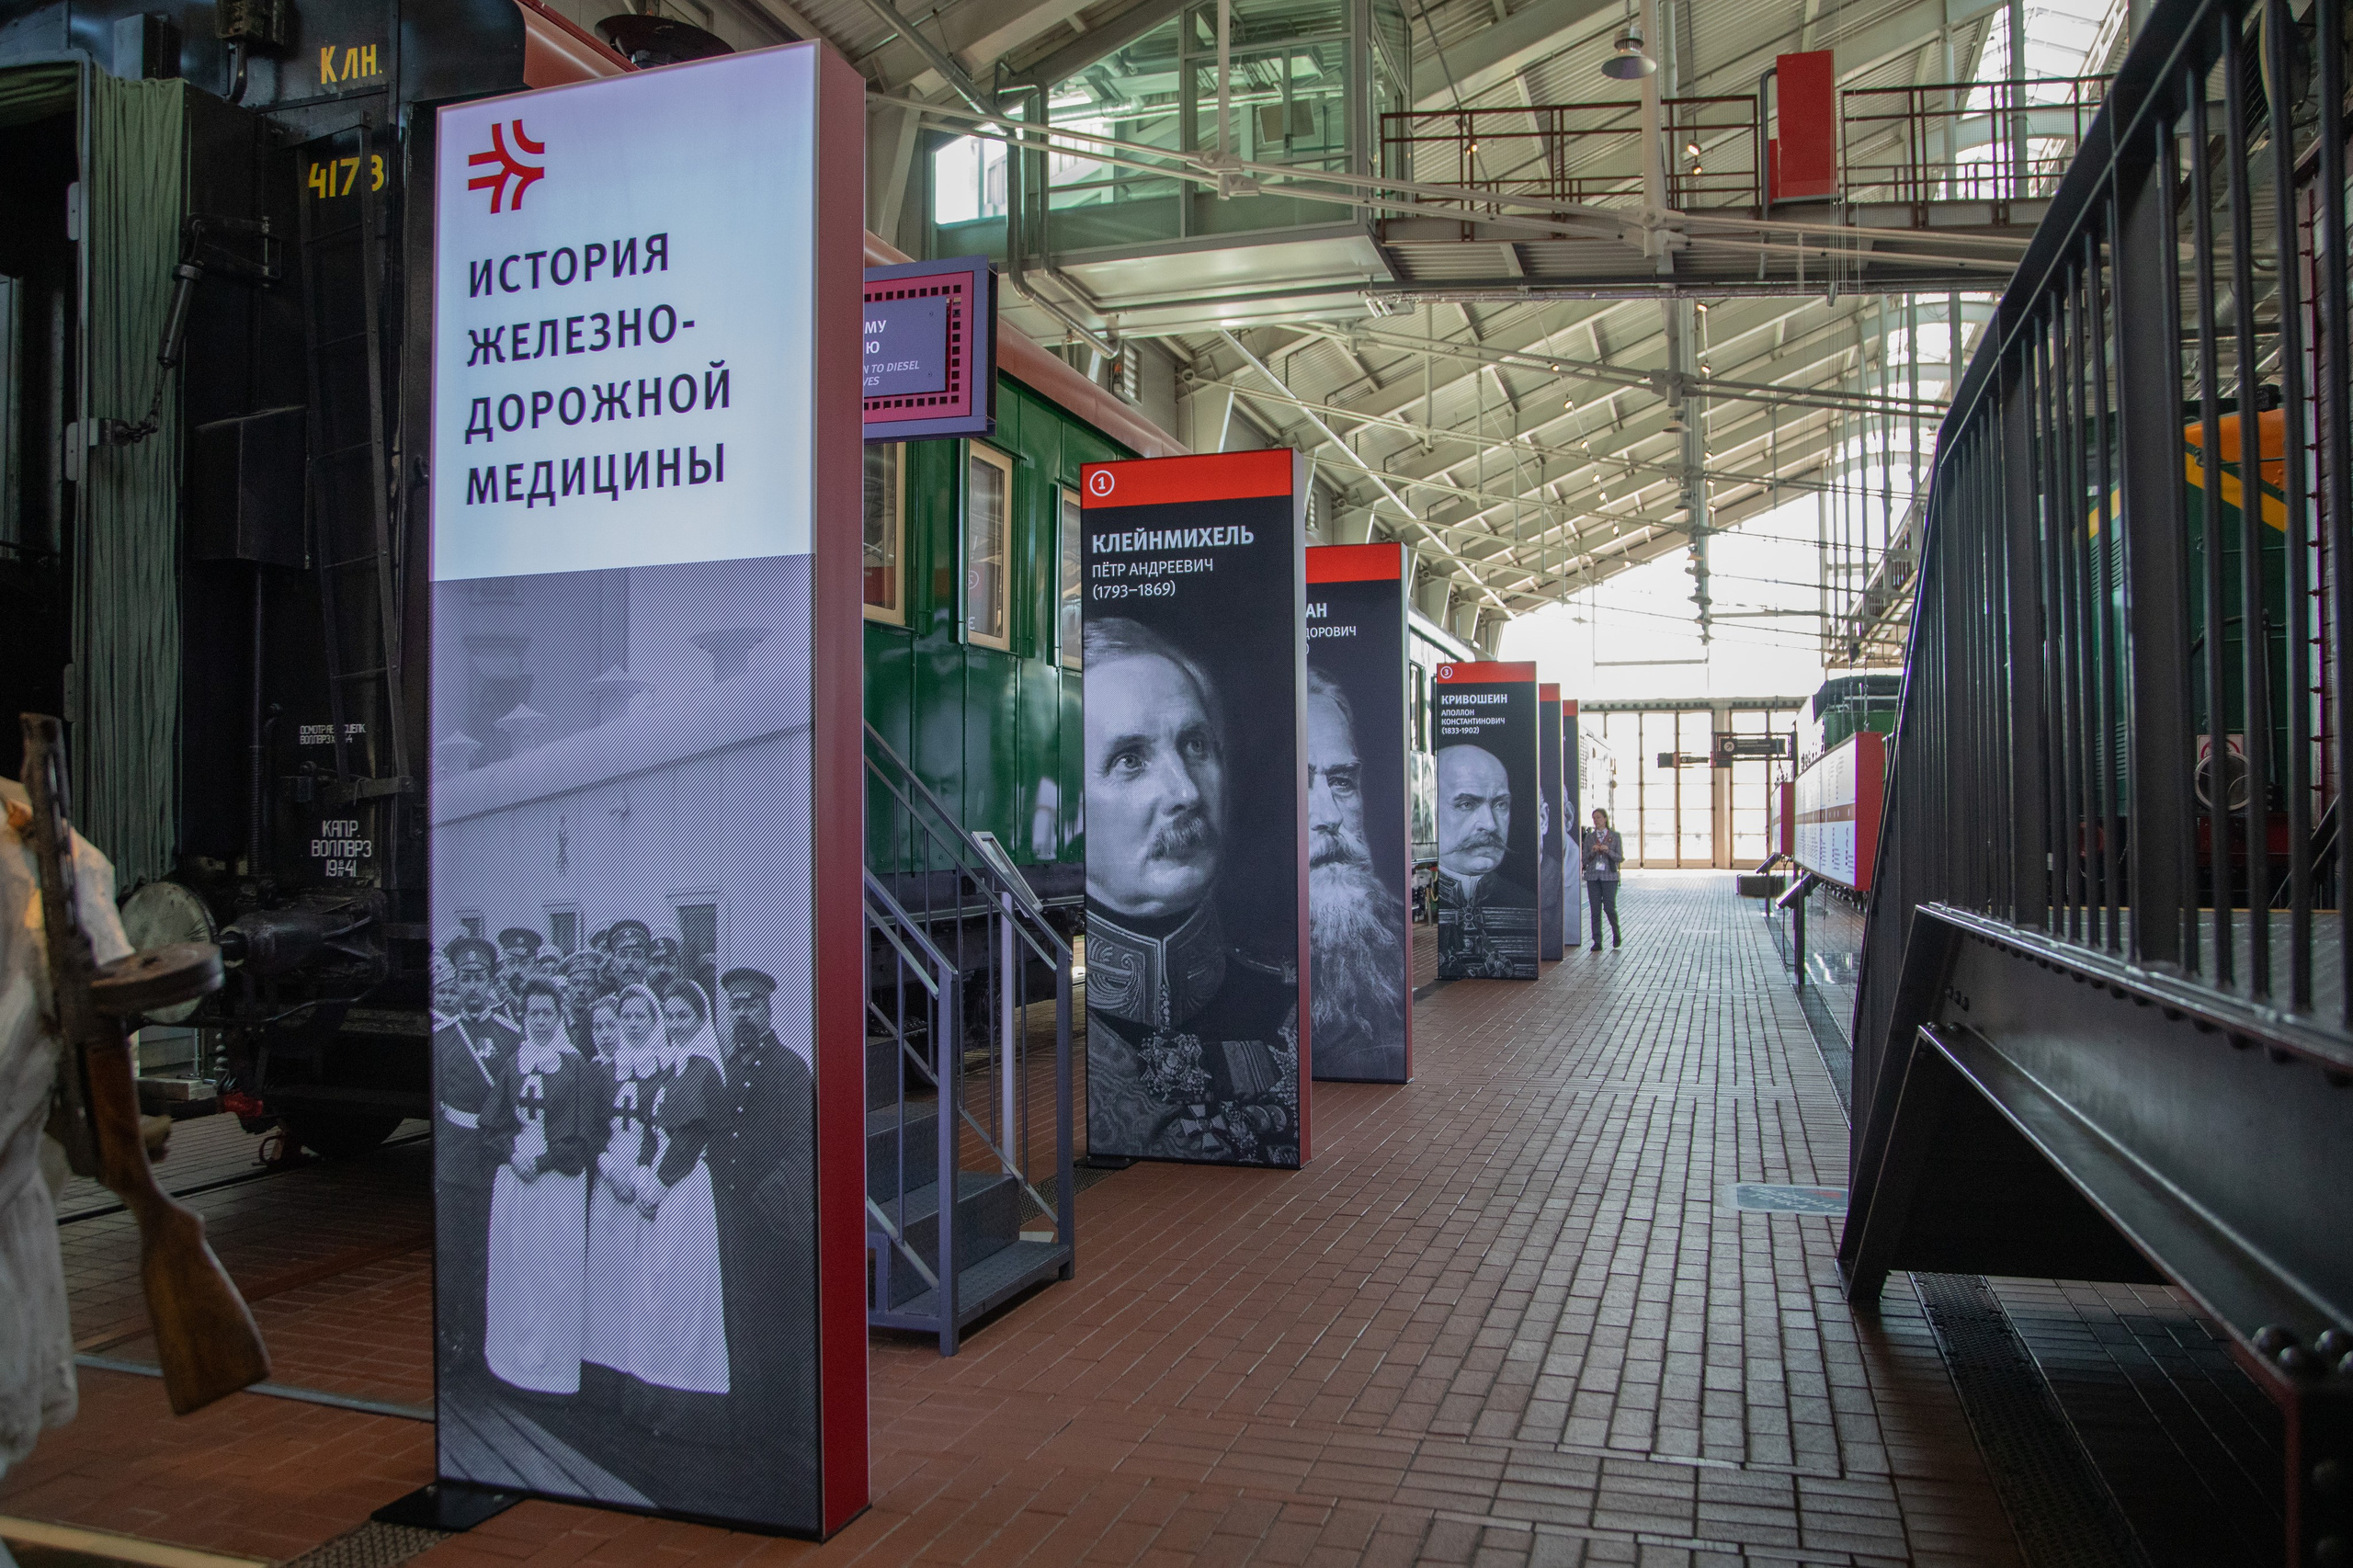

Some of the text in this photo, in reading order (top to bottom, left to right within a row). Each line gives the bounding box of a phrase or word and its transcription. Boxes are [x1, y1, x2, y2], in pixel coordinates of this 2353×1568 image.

[469, 233, 668, 298] ИСТОРИЯ
[467, 303, 695, 367] ЖЕЛЕЗНО-
[871, 363, 884, 373] TO
[886, 360, 920, 372] DIESEL
[464, 359, 730, 445] ДОРОЖНОЙ
[466, 443, 724, 508] МЕДИЦИНЫ
[1092, 525, 1255, 553] КЛЕЙНМИХЕЛЬ
[1092, 558, 1213, 578] ПЁТР АНДРЕЕВИЧ
[1441, 694, 1507, 705] КРИВОШЕИН
[1441, 717, 1506, 725] КОНСТАНТИНОВИЧ
[1441, 726, 1480, 734] (1833-1902)
